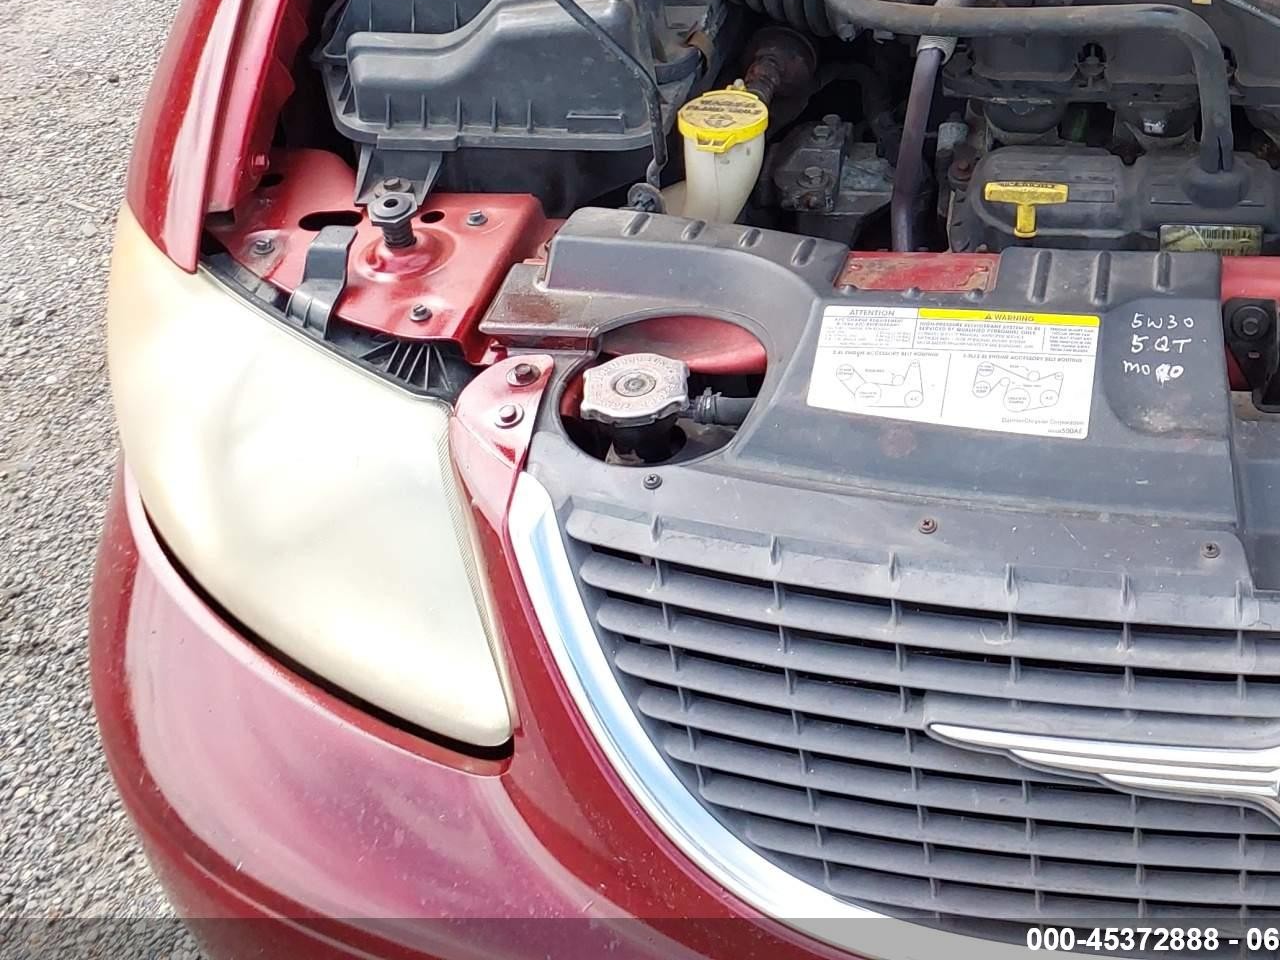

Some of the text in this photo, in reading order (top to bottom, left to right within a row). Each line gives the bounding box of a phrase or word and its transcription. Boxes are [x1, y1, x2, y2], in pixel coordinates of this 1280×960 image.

[848, 309, 896, 317] ATTENTION
[994, 314, 1035, 323] WARNING
[1130, 312, 1194, 329] 5W30
[1131, 334, 1192, 354] 5 QT
